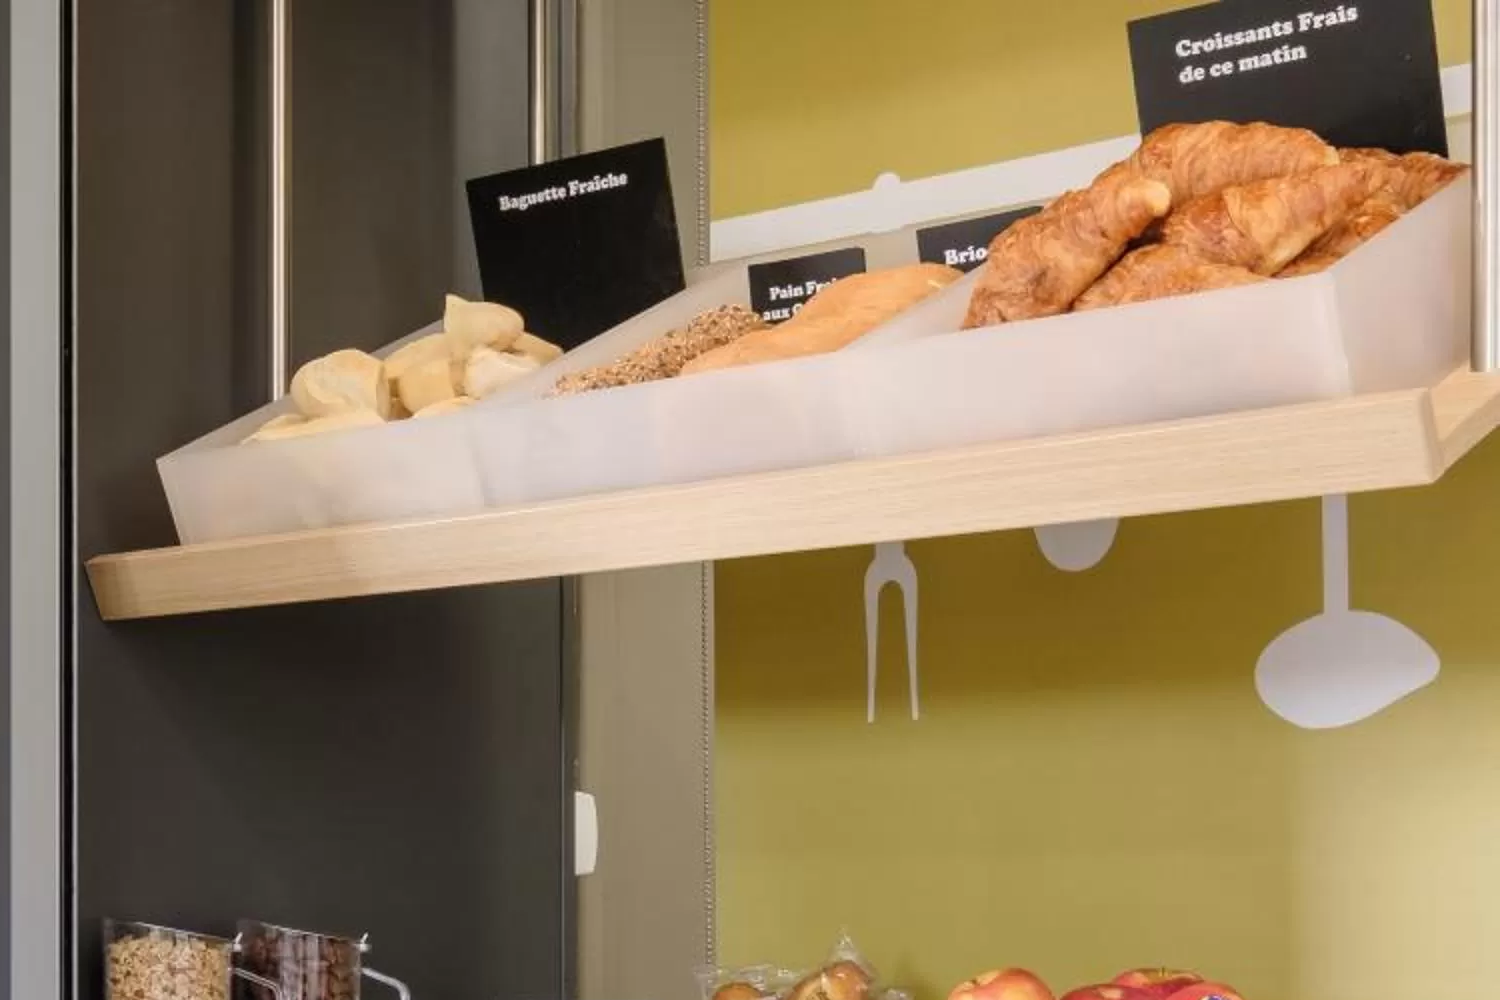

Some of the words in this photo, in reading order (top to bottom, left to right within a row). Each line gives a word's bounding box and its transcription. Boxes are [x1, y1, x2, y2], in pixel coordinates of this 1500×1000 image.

[1175, 20, 1293, 57] Croissants
[1297, 5, 1358, 31] Frais
[1179, 65, 1205, 84] de
[1209, 61, 1234, 78] ce
[1239, 43, 1307, 71] matin
[500, 187, 567, 210] Baguette
[944, 245, 987, 265] Brio
[769, 284, 804, 300] Pain
[763, 307, 790, 321] aux
